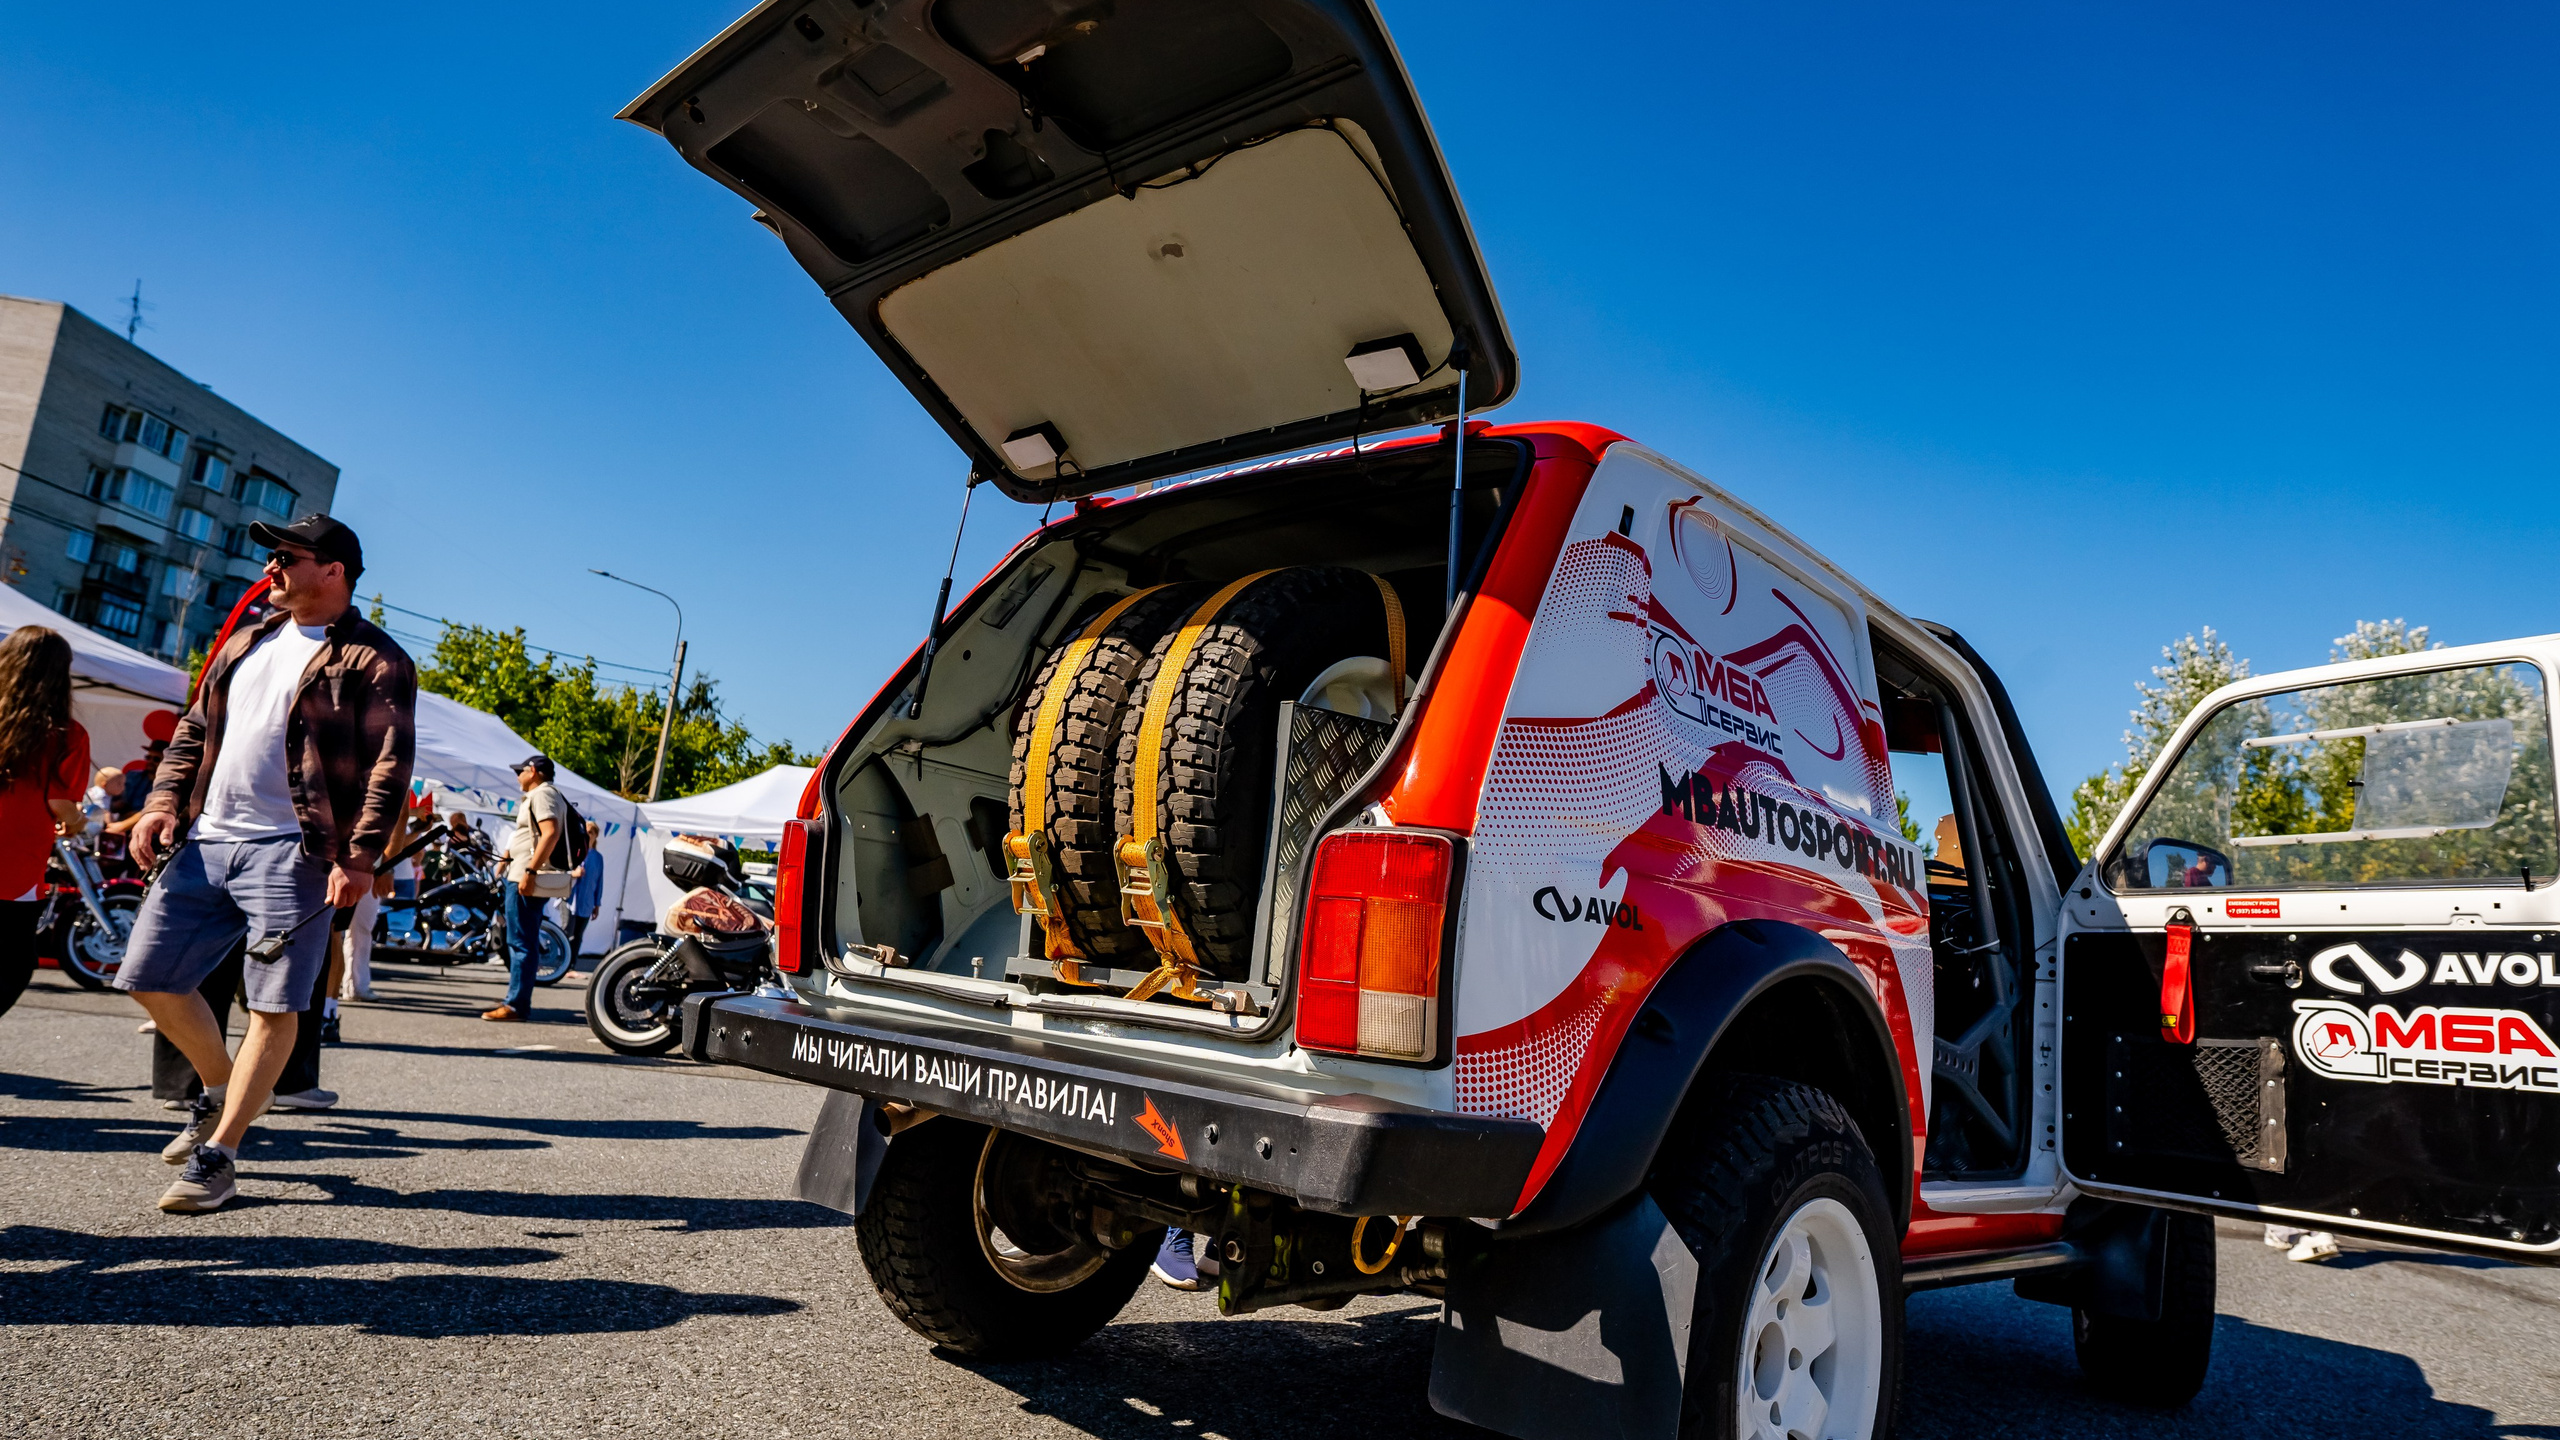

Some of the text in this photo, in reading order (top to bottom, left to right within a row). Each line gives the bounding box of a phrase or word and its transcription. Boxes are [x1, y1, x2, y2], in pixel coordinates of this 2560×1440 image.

[1706, 703, 1783, 755] СЕРВИС
[1659, 760, 1916, 892] MBAUTOSPORT.RU
[1584, 896, 1644, 931] AVOL
[2431, 953, 2560, 986] AVOL
[791, 1032, 1117, 1127] МЫ ЧИТАЛИ ВАШИ ПРАВИЛА!
[2389, 1058, 2560, 1088] СЕРВИС
